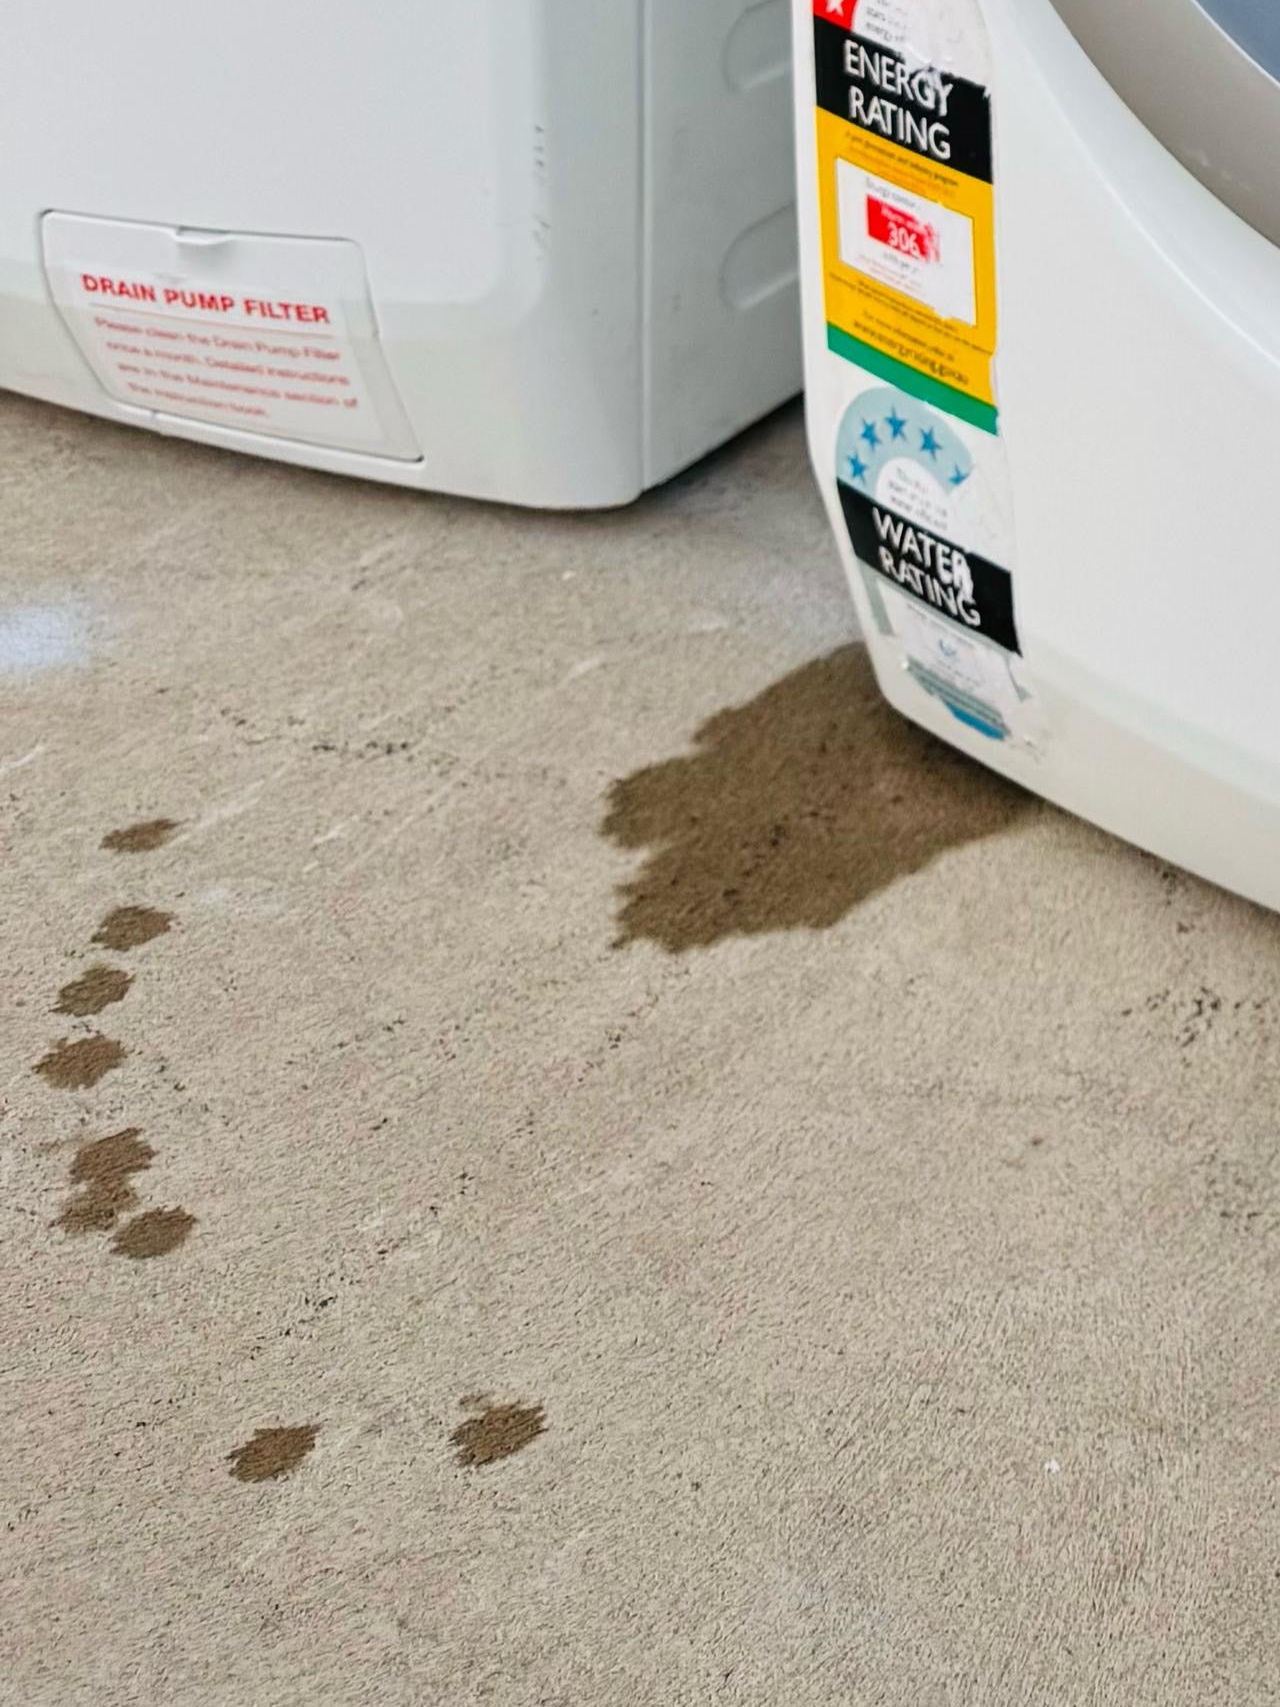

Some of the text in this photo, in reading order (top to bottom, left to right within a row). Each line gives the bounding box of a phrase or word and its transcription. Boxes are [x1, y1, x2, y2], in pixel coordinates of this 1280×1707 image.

[844, 39, 953, 116] ENERGY
[850, 85, 951, 159] RATING
[81, 274, 331, 324] DRAIN PUMP FILTER
[873, 507, 972, 590] WATER
[879, 547, 980, 626] RATING
